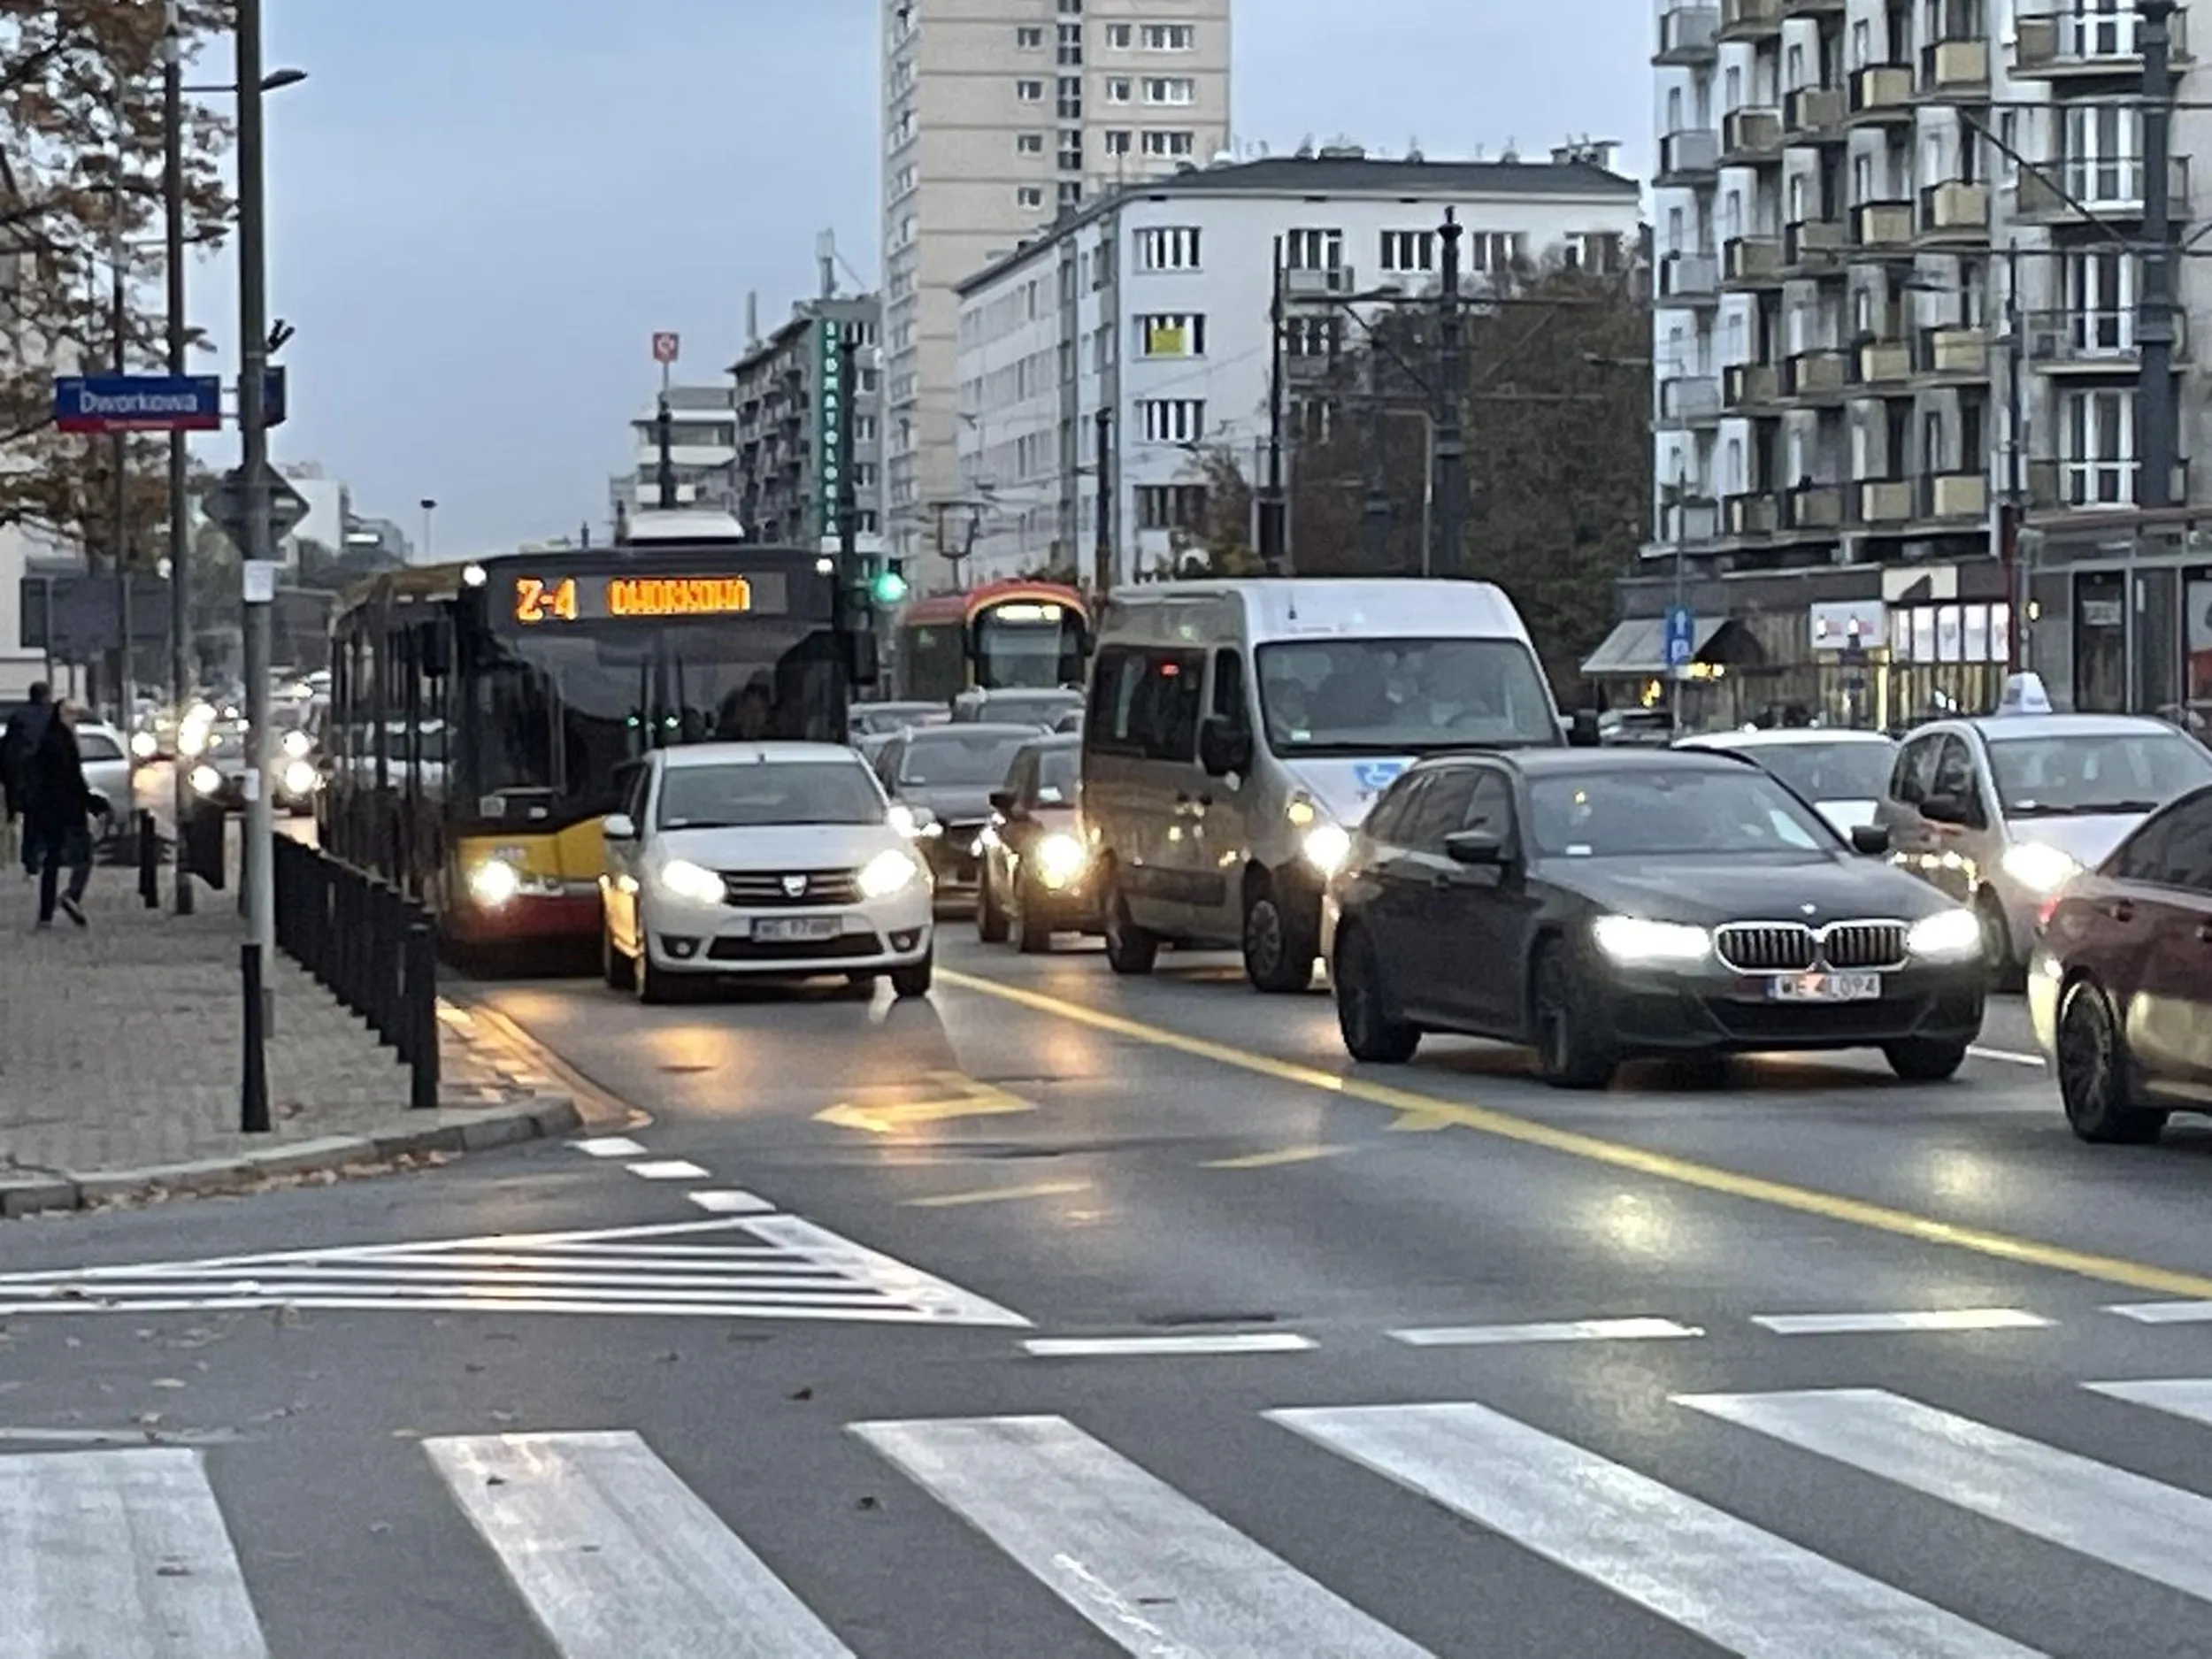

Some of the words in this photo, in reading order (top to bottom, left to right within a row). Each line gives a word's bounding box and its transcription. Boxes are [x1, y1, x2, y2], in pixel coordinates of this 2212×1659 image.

[80, 389, 197, 413] Dworkowa
[824, 320, 839, 534] STOMATOLOGIA
[517, 578, 578, 620] Z-4
